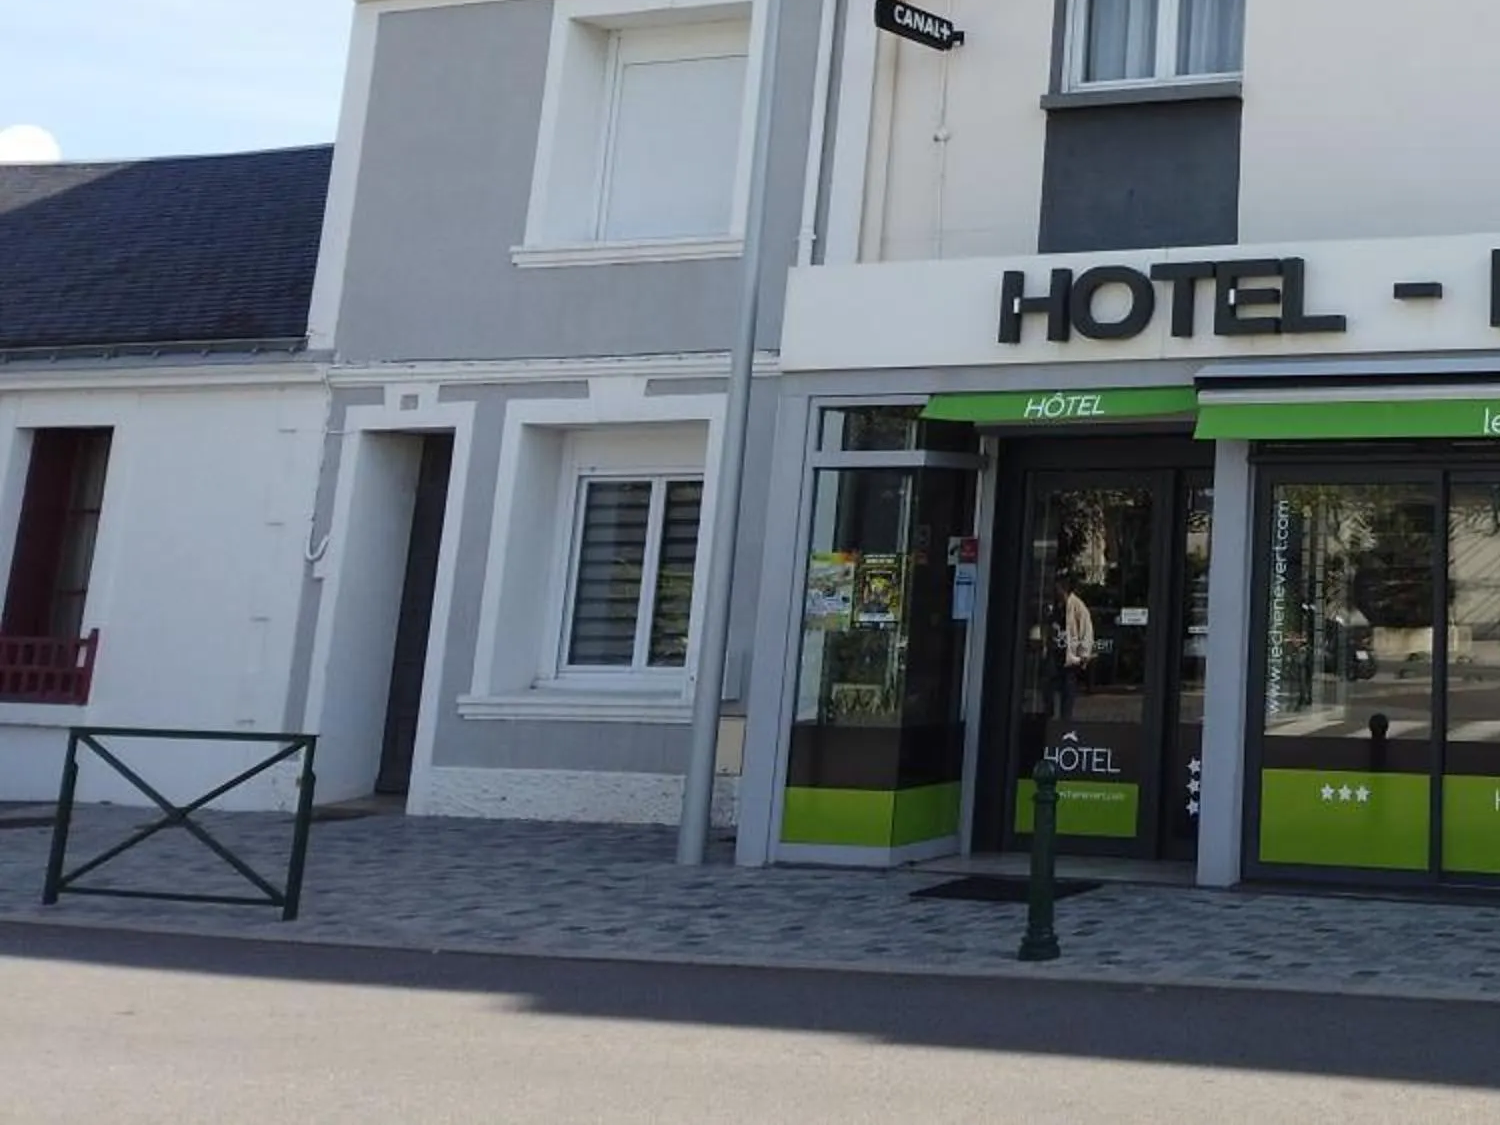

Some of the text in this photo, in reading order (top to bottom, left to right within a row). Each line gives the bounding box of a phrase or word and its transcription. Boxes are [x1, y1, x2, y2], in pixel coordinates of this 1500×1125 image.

[893, 4, 951, 41] CANAL+
[998, 256, 1347, 344] HOTEL
[1023, 392, 1106, 419] HÔTEL
[1265, 499, 1290, 716] www.lechenevert.com
[1043, 730, 1121, 773] HÔTEL
